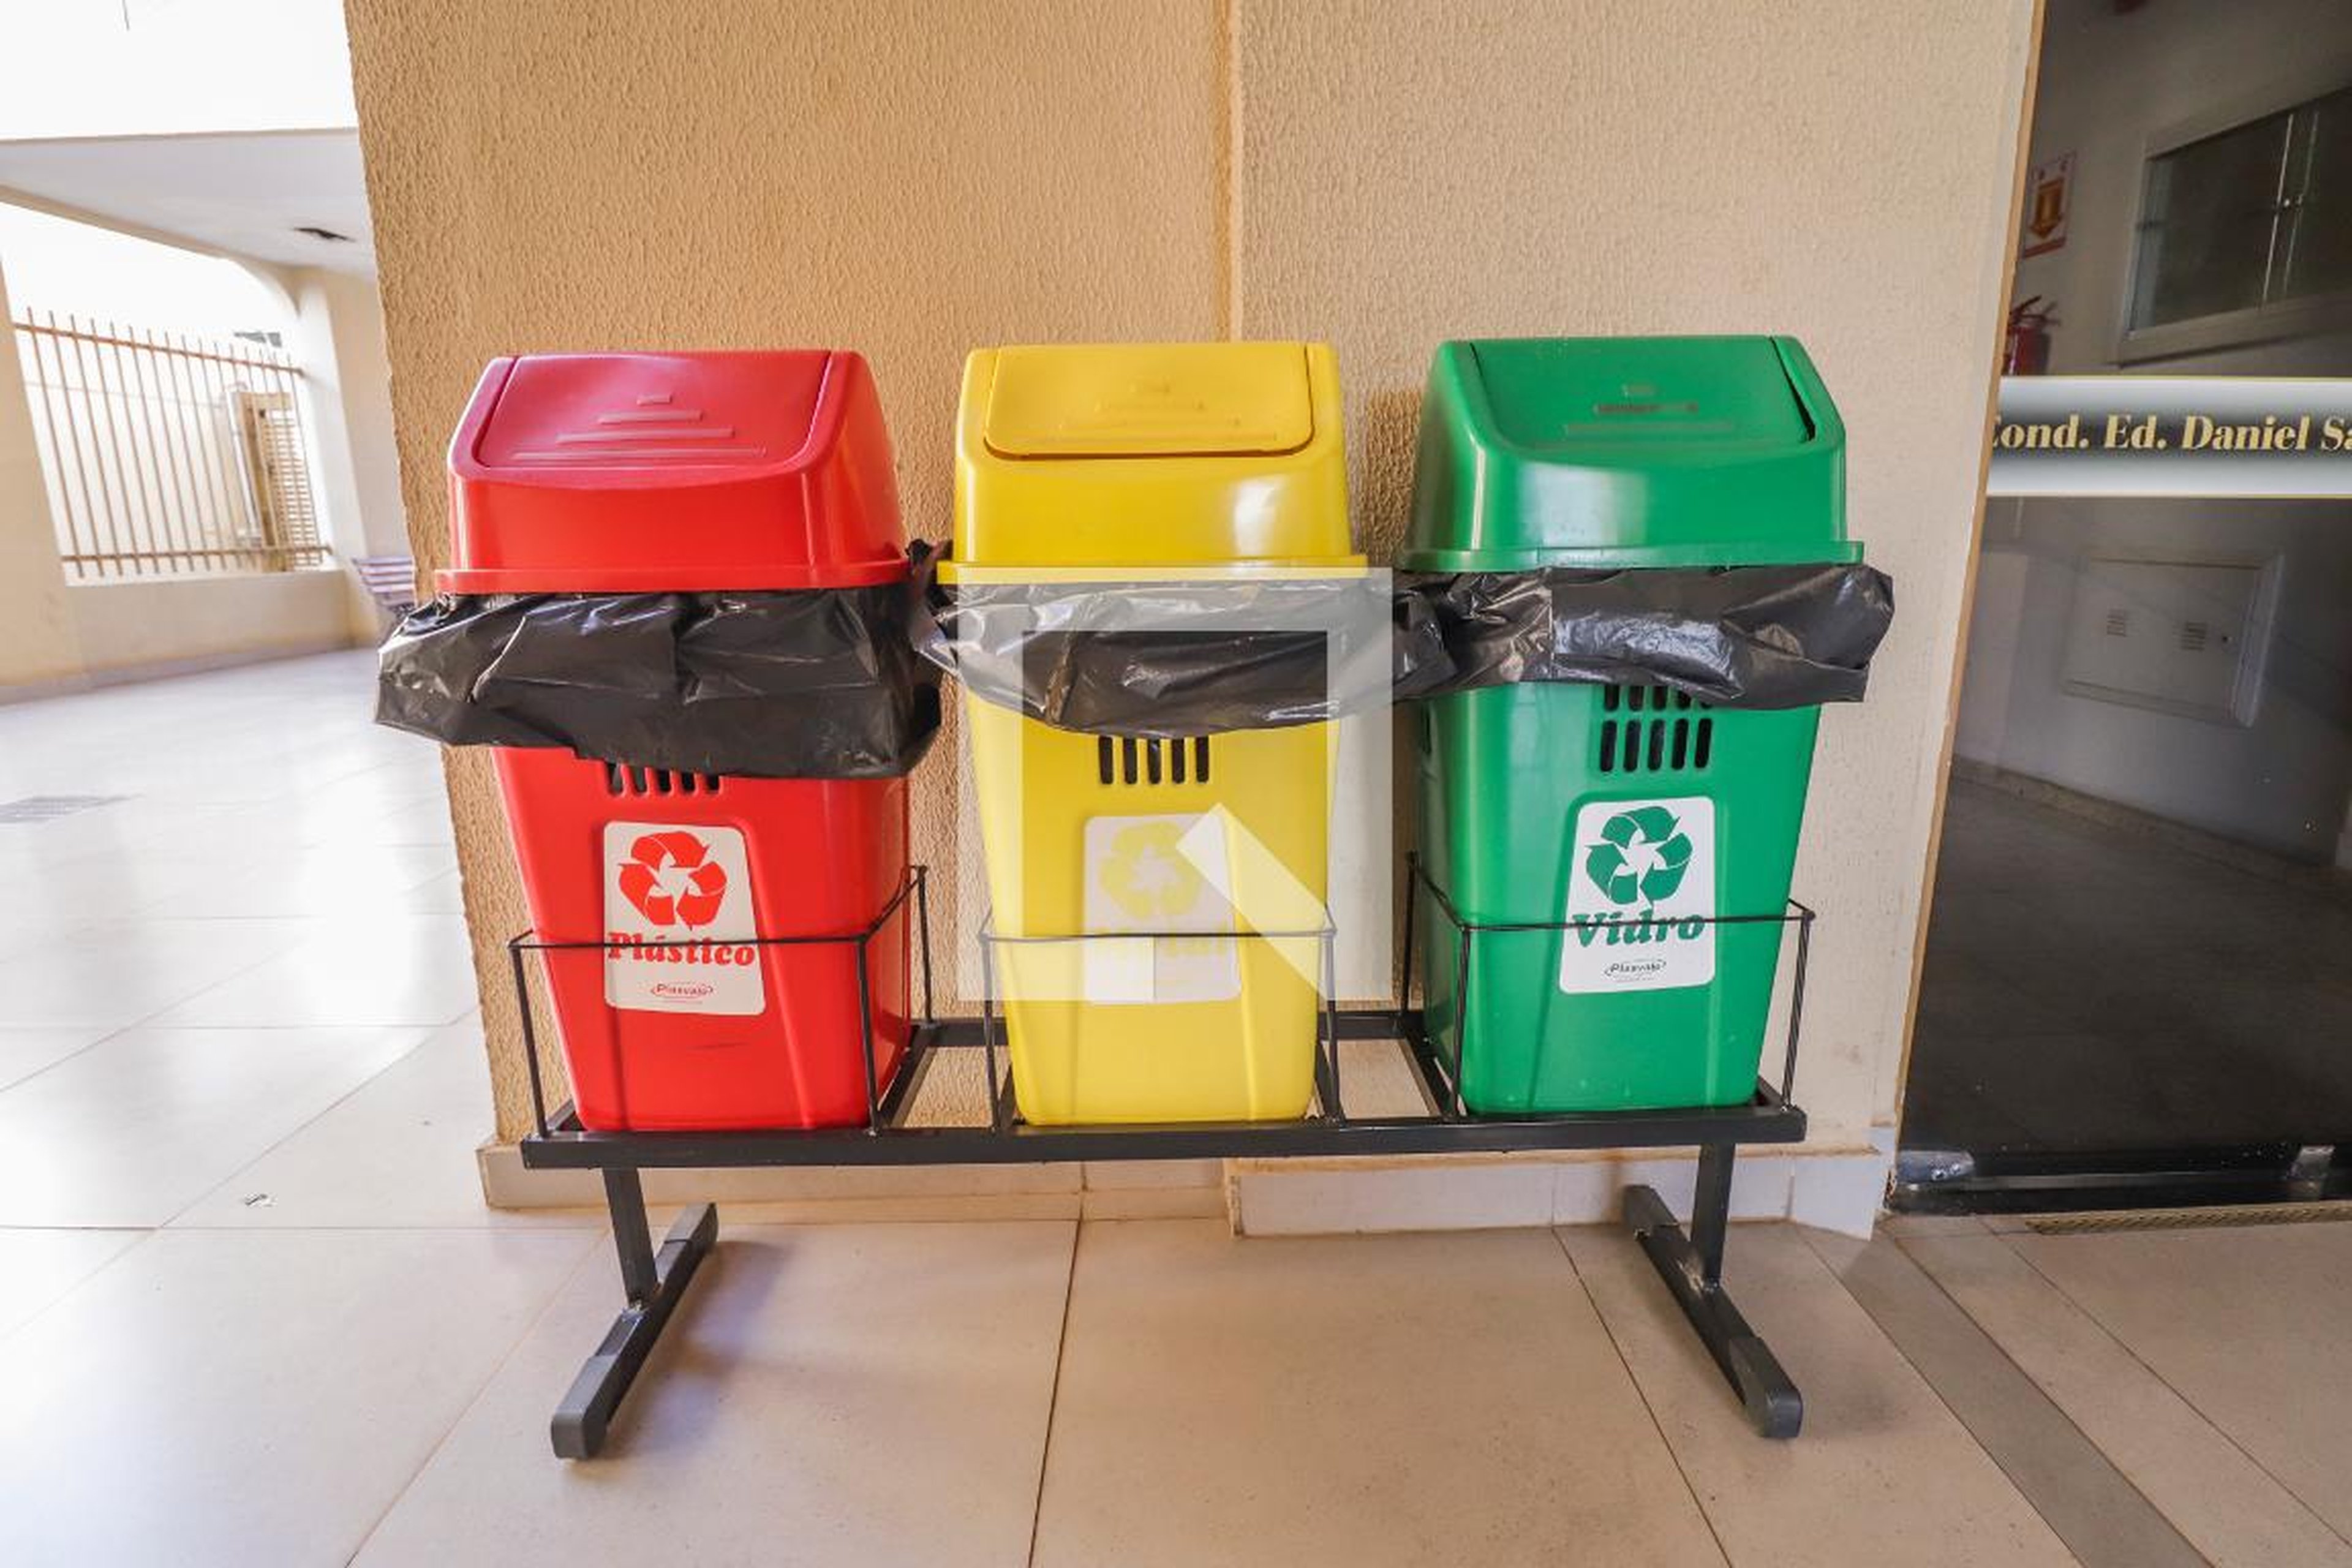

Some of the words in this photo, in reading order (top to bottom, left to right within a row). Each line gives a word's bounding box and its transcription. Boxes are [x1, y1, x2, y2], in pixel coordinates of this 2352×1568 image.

[2103, 413, 2167, 449] Ed.
[2180, 414, 2310, 451] Daniel
[1572, 908, 1705, 948] Vidro
[608, 932, 755, 967] Plástico
